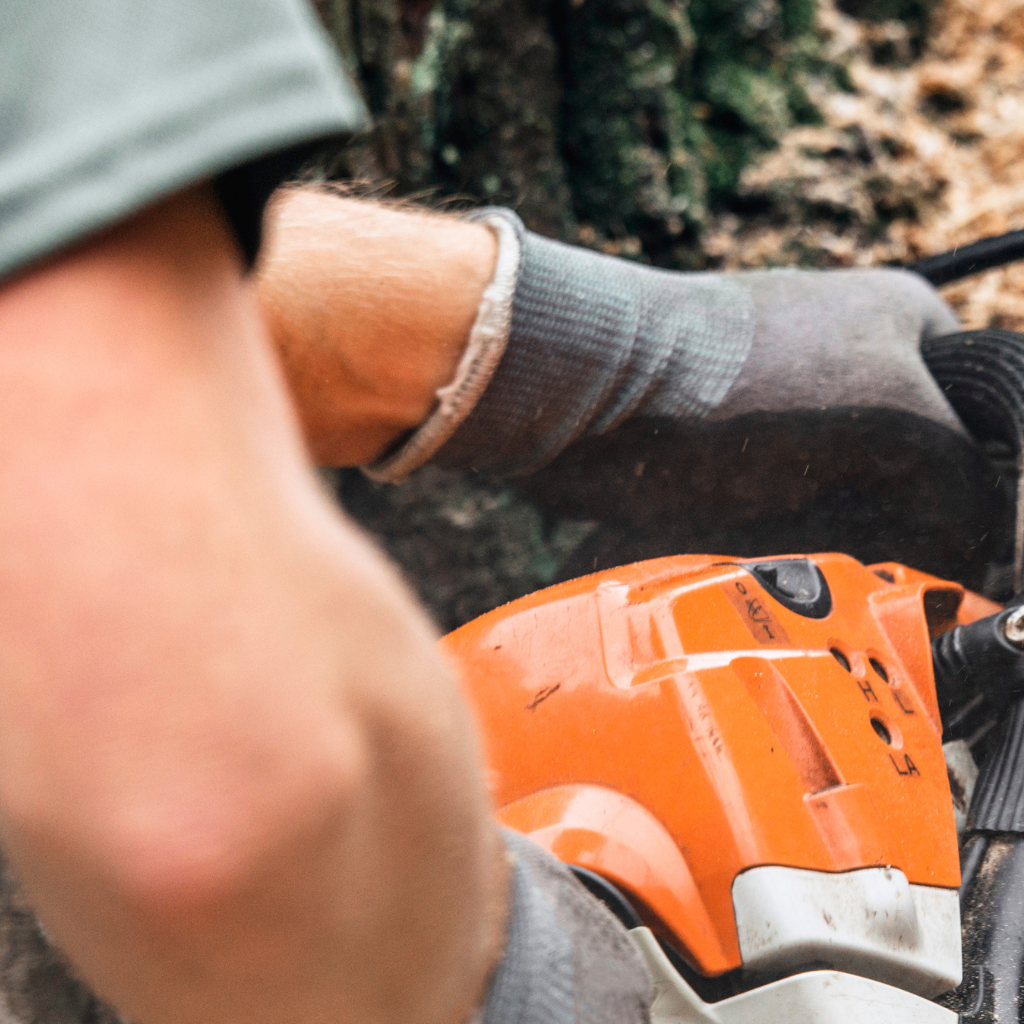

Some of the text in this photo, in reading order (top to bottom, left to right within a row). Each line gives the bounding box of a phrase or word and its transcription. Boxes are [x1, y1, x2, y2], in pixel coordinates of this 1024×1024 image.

[857, 680, 878, 702] H
[893, 691, 915, 714] L
[888, 753, 921, 776] LA
